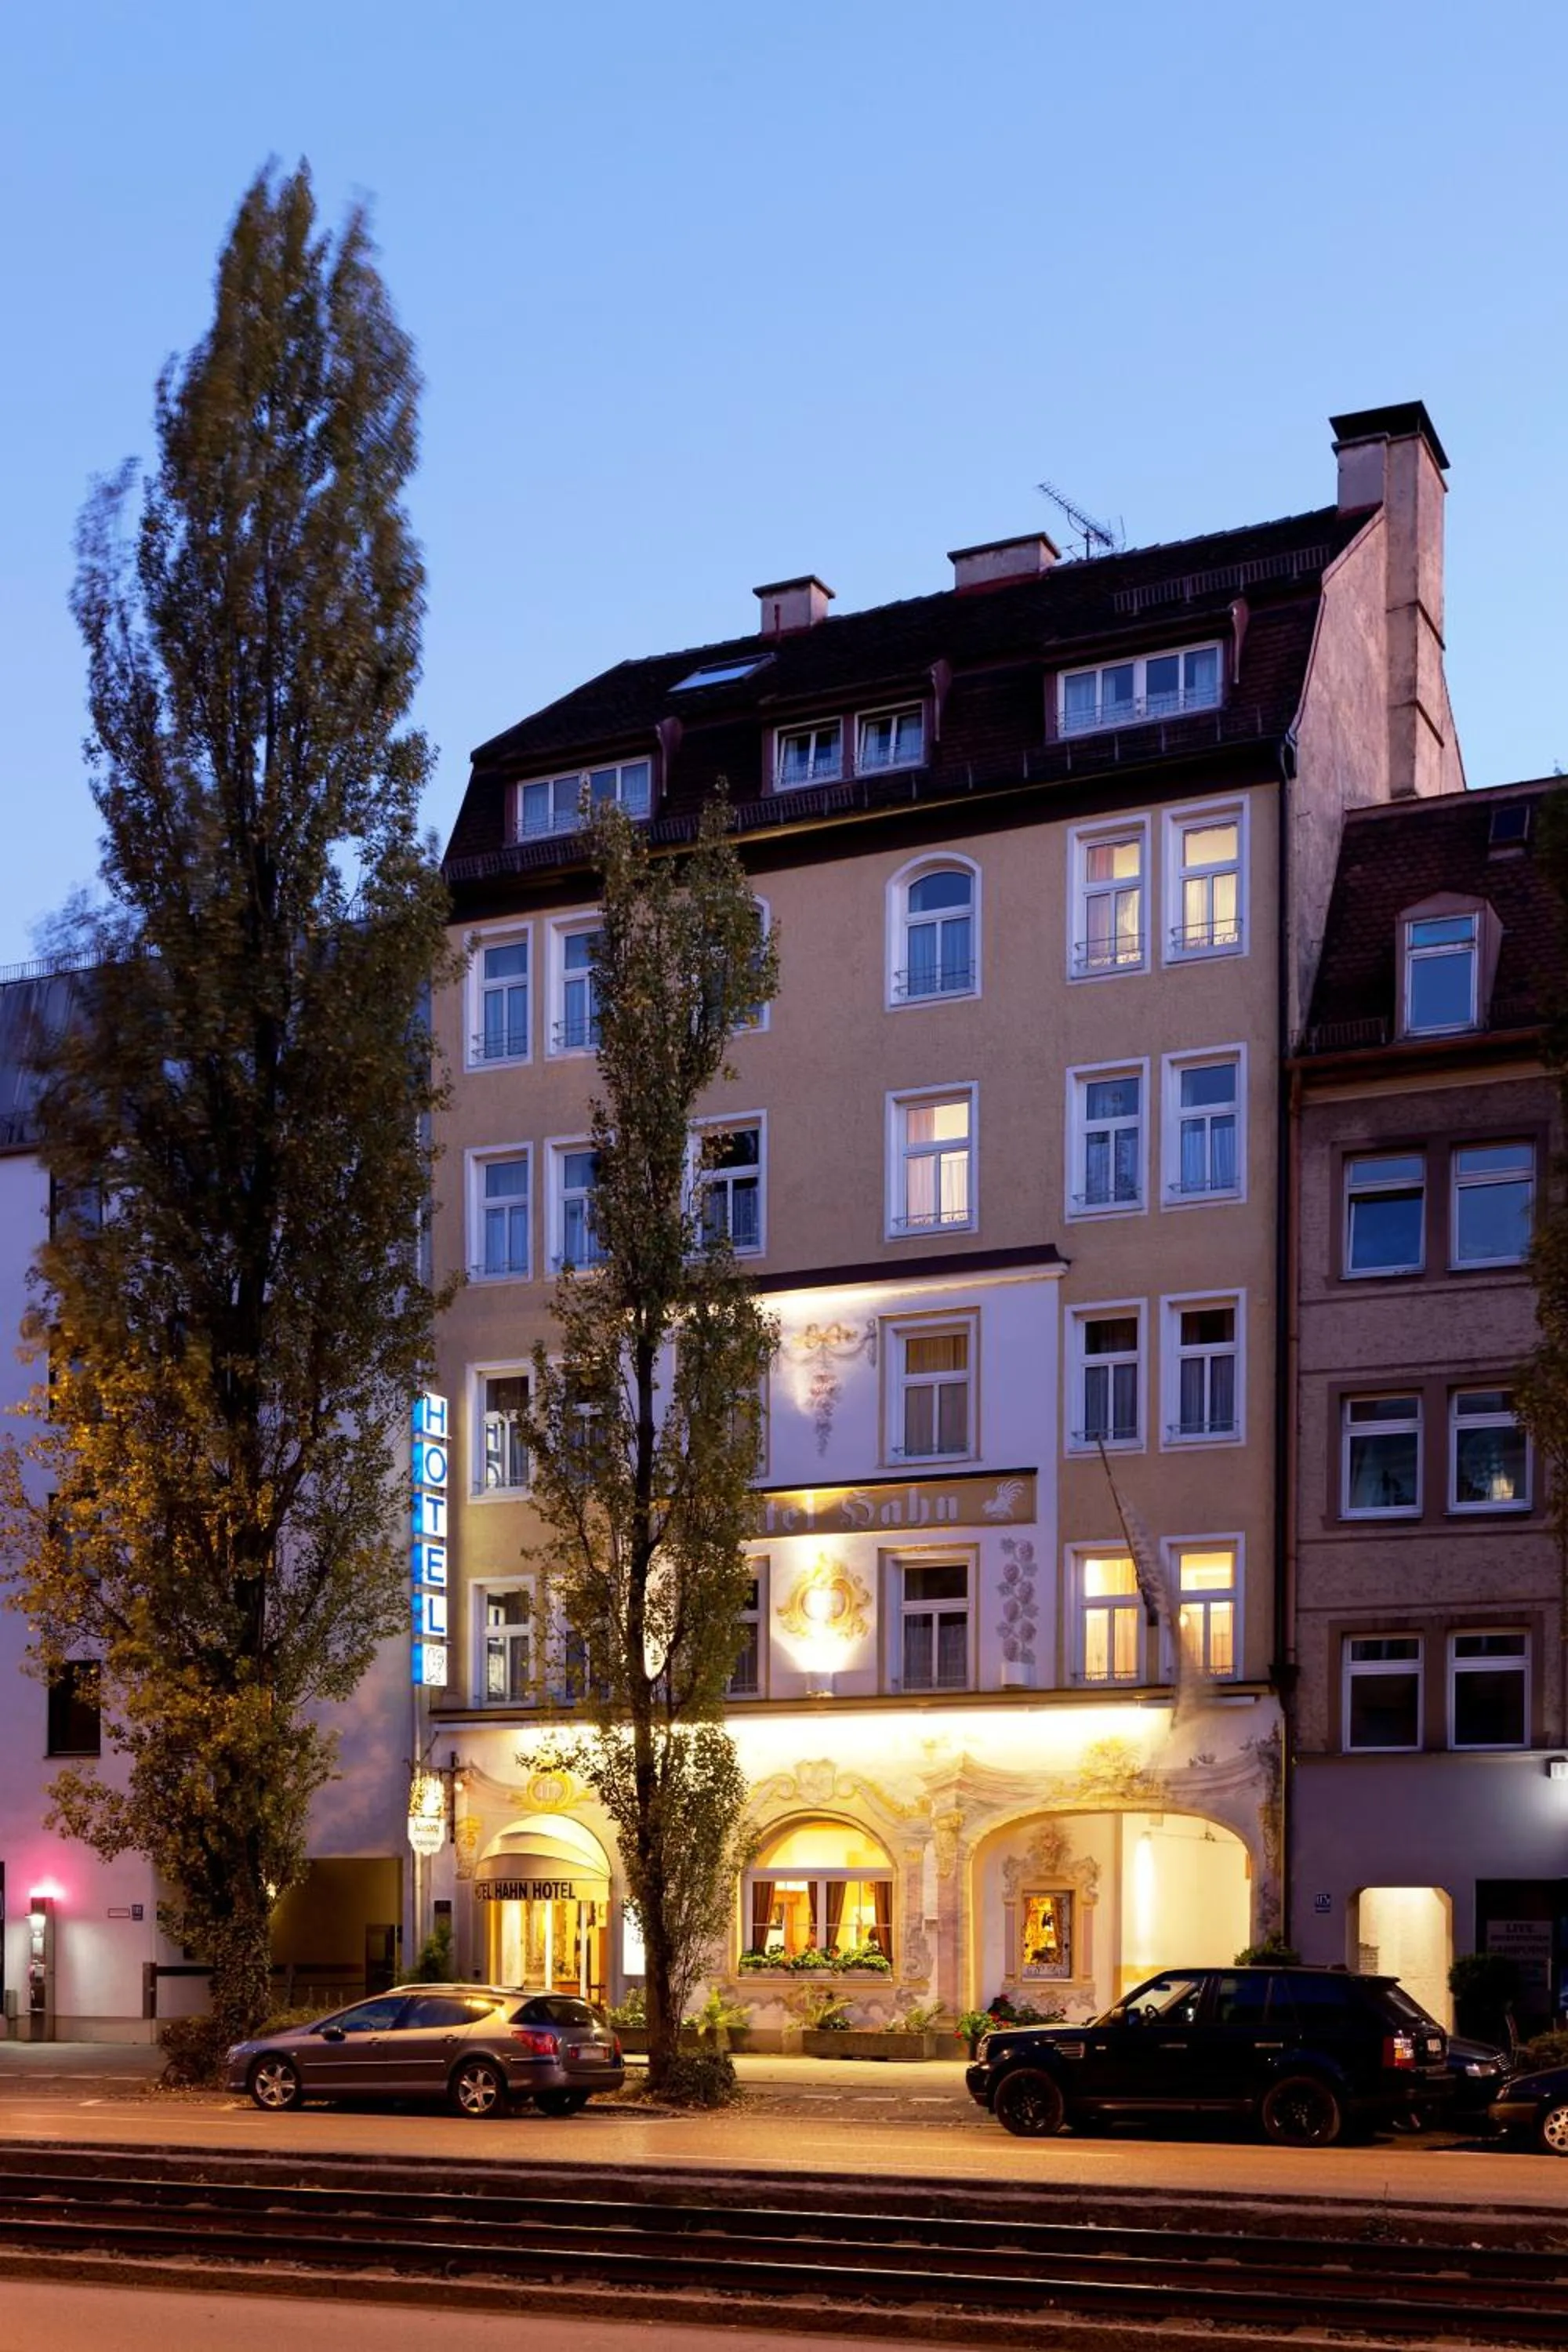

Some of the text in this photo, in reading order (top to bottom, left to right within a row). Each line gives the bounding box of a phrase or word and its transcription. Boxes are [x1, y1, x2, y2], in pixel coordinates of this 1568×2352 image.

[424, 1399, 447, 1633] HOTEL
[495, 1882, 528, 1900] HAHN
[532, 1882, 575, 1900] HOTEL
